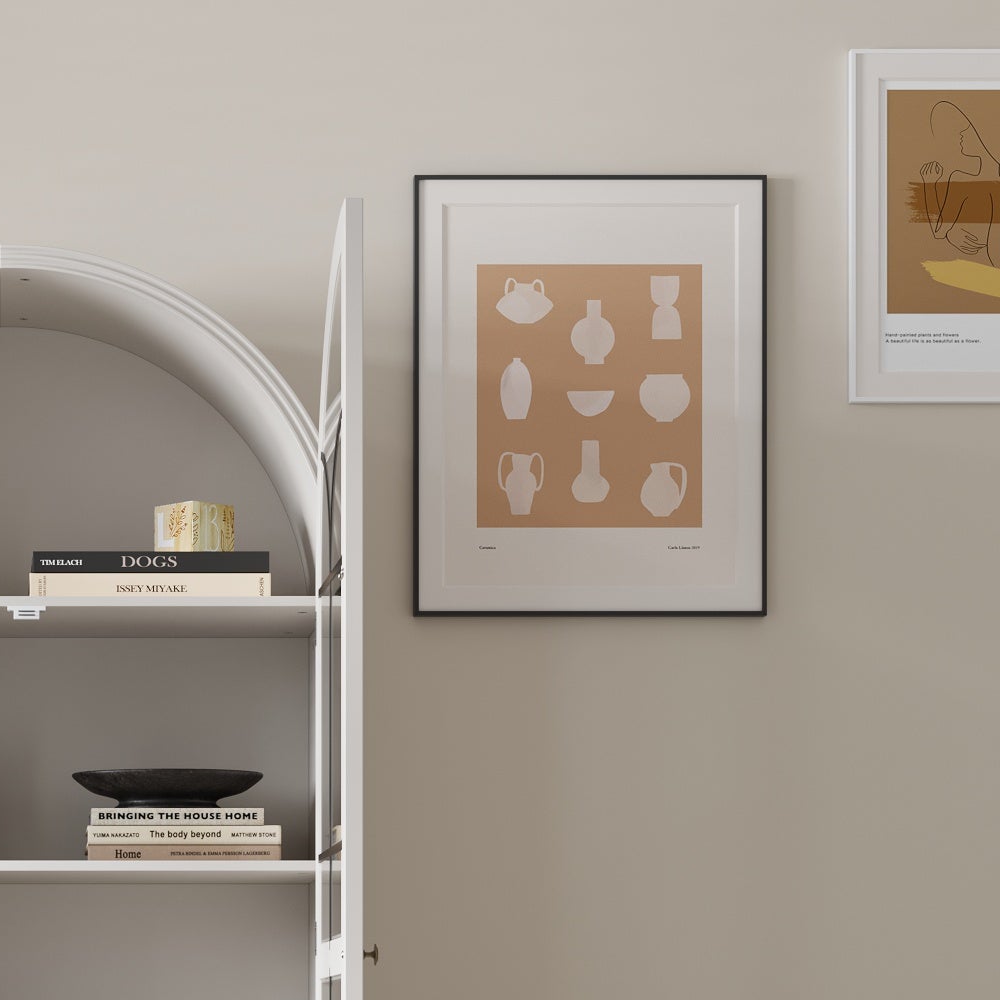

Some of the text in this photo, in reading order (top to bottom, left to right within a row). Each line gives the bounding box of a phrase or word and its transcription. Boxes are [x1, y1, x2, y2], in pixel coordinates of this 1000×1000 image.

[121, 555, 178, 568] DOGS
[116, 584, 188, 593] ISSEY MIYAKE
[98, 812, 258, 820] BRINGING THE HOUSE HOME
[150, 830, 222, 840] The body beyond
[115, 849, 142, 859] Home
